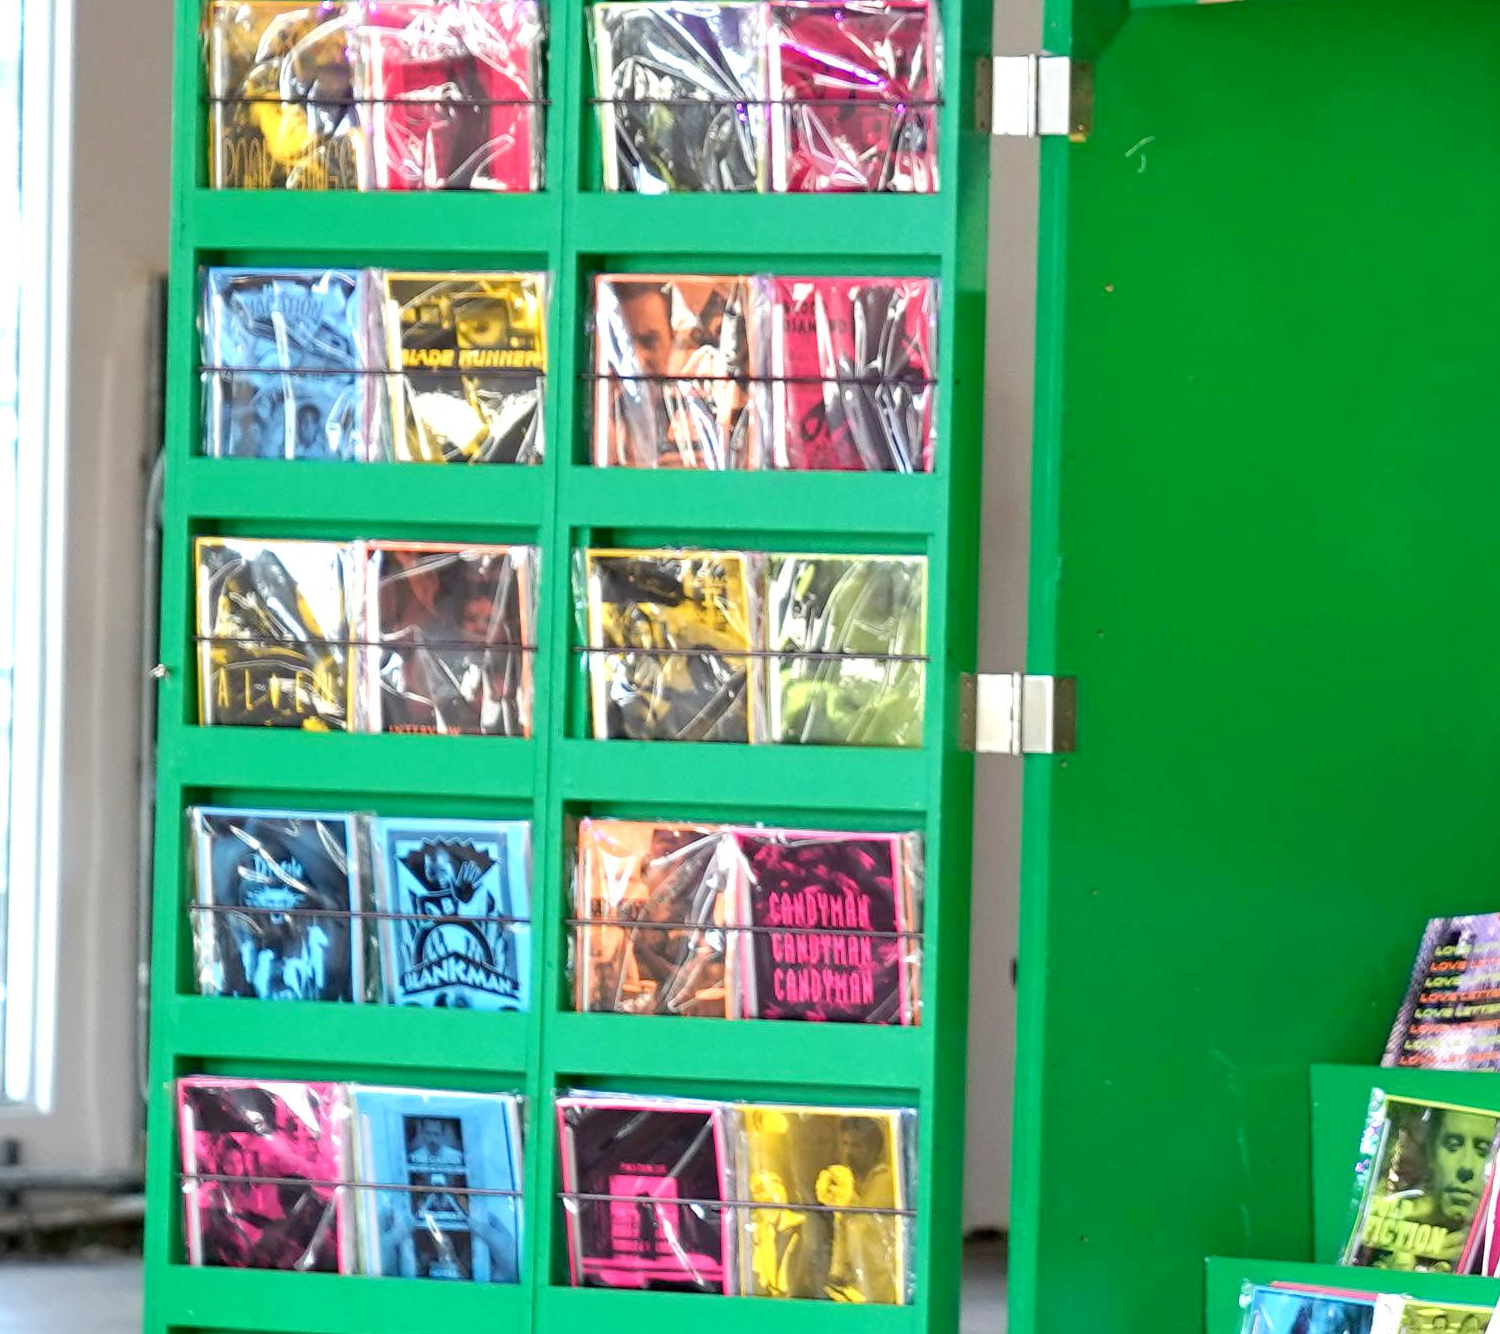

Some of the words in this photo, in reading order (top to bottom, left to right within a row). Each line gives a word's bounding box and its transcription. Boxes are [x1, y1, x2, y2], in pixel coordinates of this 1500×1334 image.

[769, 891, 872, 929] CANDYMAN
[772, 931, 873, 966] CANDYMAN
[774, 969, 874, 1005] CANDYMAN
[1419, 992, 1457, 1004] LOVE
[1414, 1008, 1454, 1019] LOVE
[1361, 1215, 1449, 1254] FICTION
